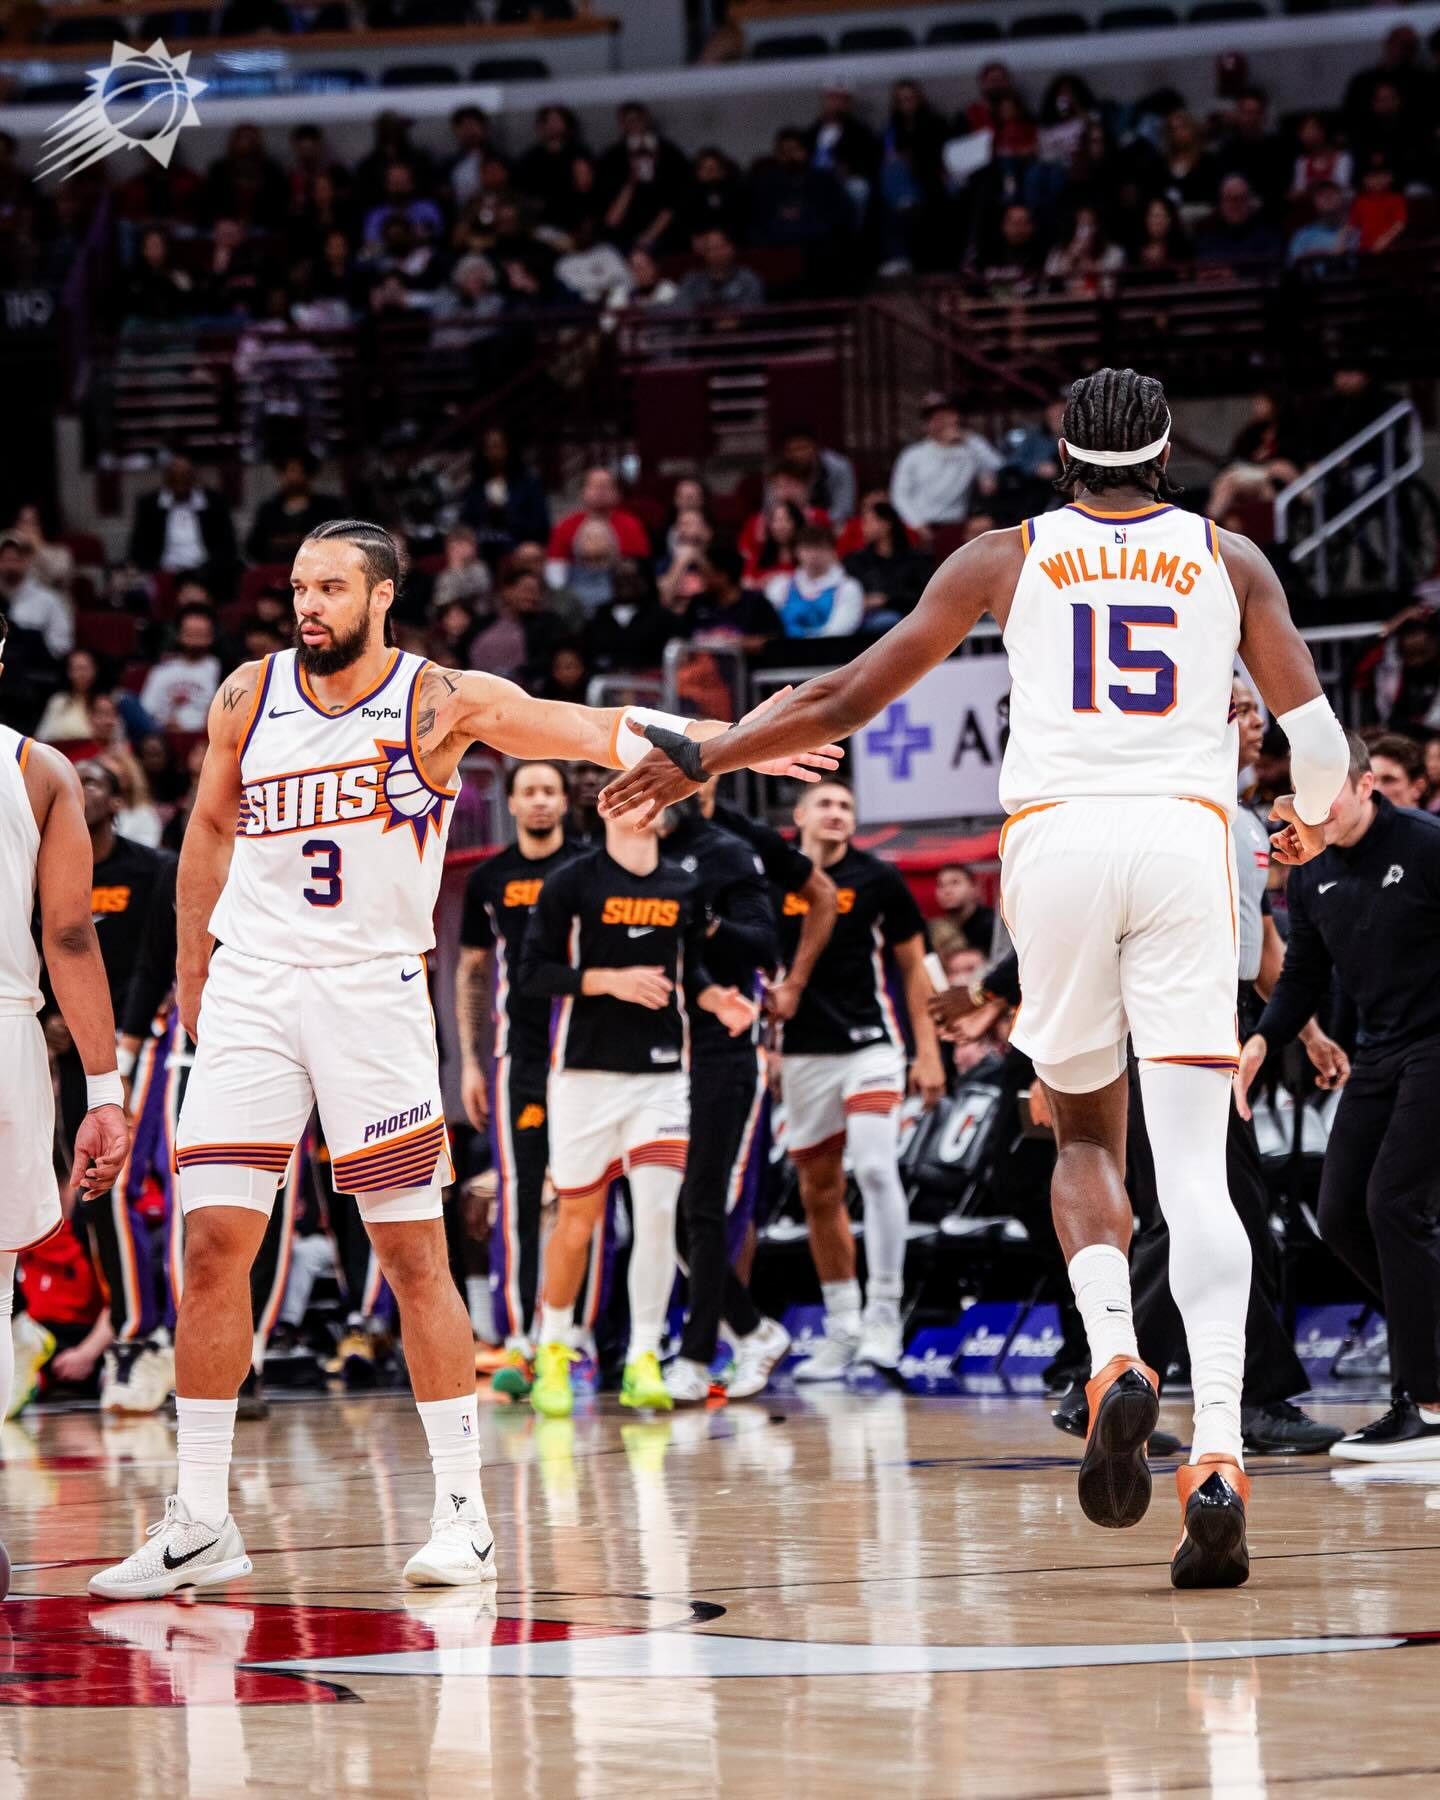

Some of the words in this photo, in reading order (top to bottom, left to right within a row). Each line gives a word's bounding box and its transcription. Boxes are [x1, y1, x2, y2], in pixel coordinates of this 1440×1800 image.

[1039, 546, 1202, 595] WILLIAMS
[1070, 603, 1178, 717] 15
[361, 707, 402, 720] PayPal
[246, 765, 378, 835] SUNS
[302, 839, 343, 908] 3
[503, 879, 545, 907] SU
[602, 896, 681, 928] SUNS
[364, 1099, 432, 1143] PHOENIX
